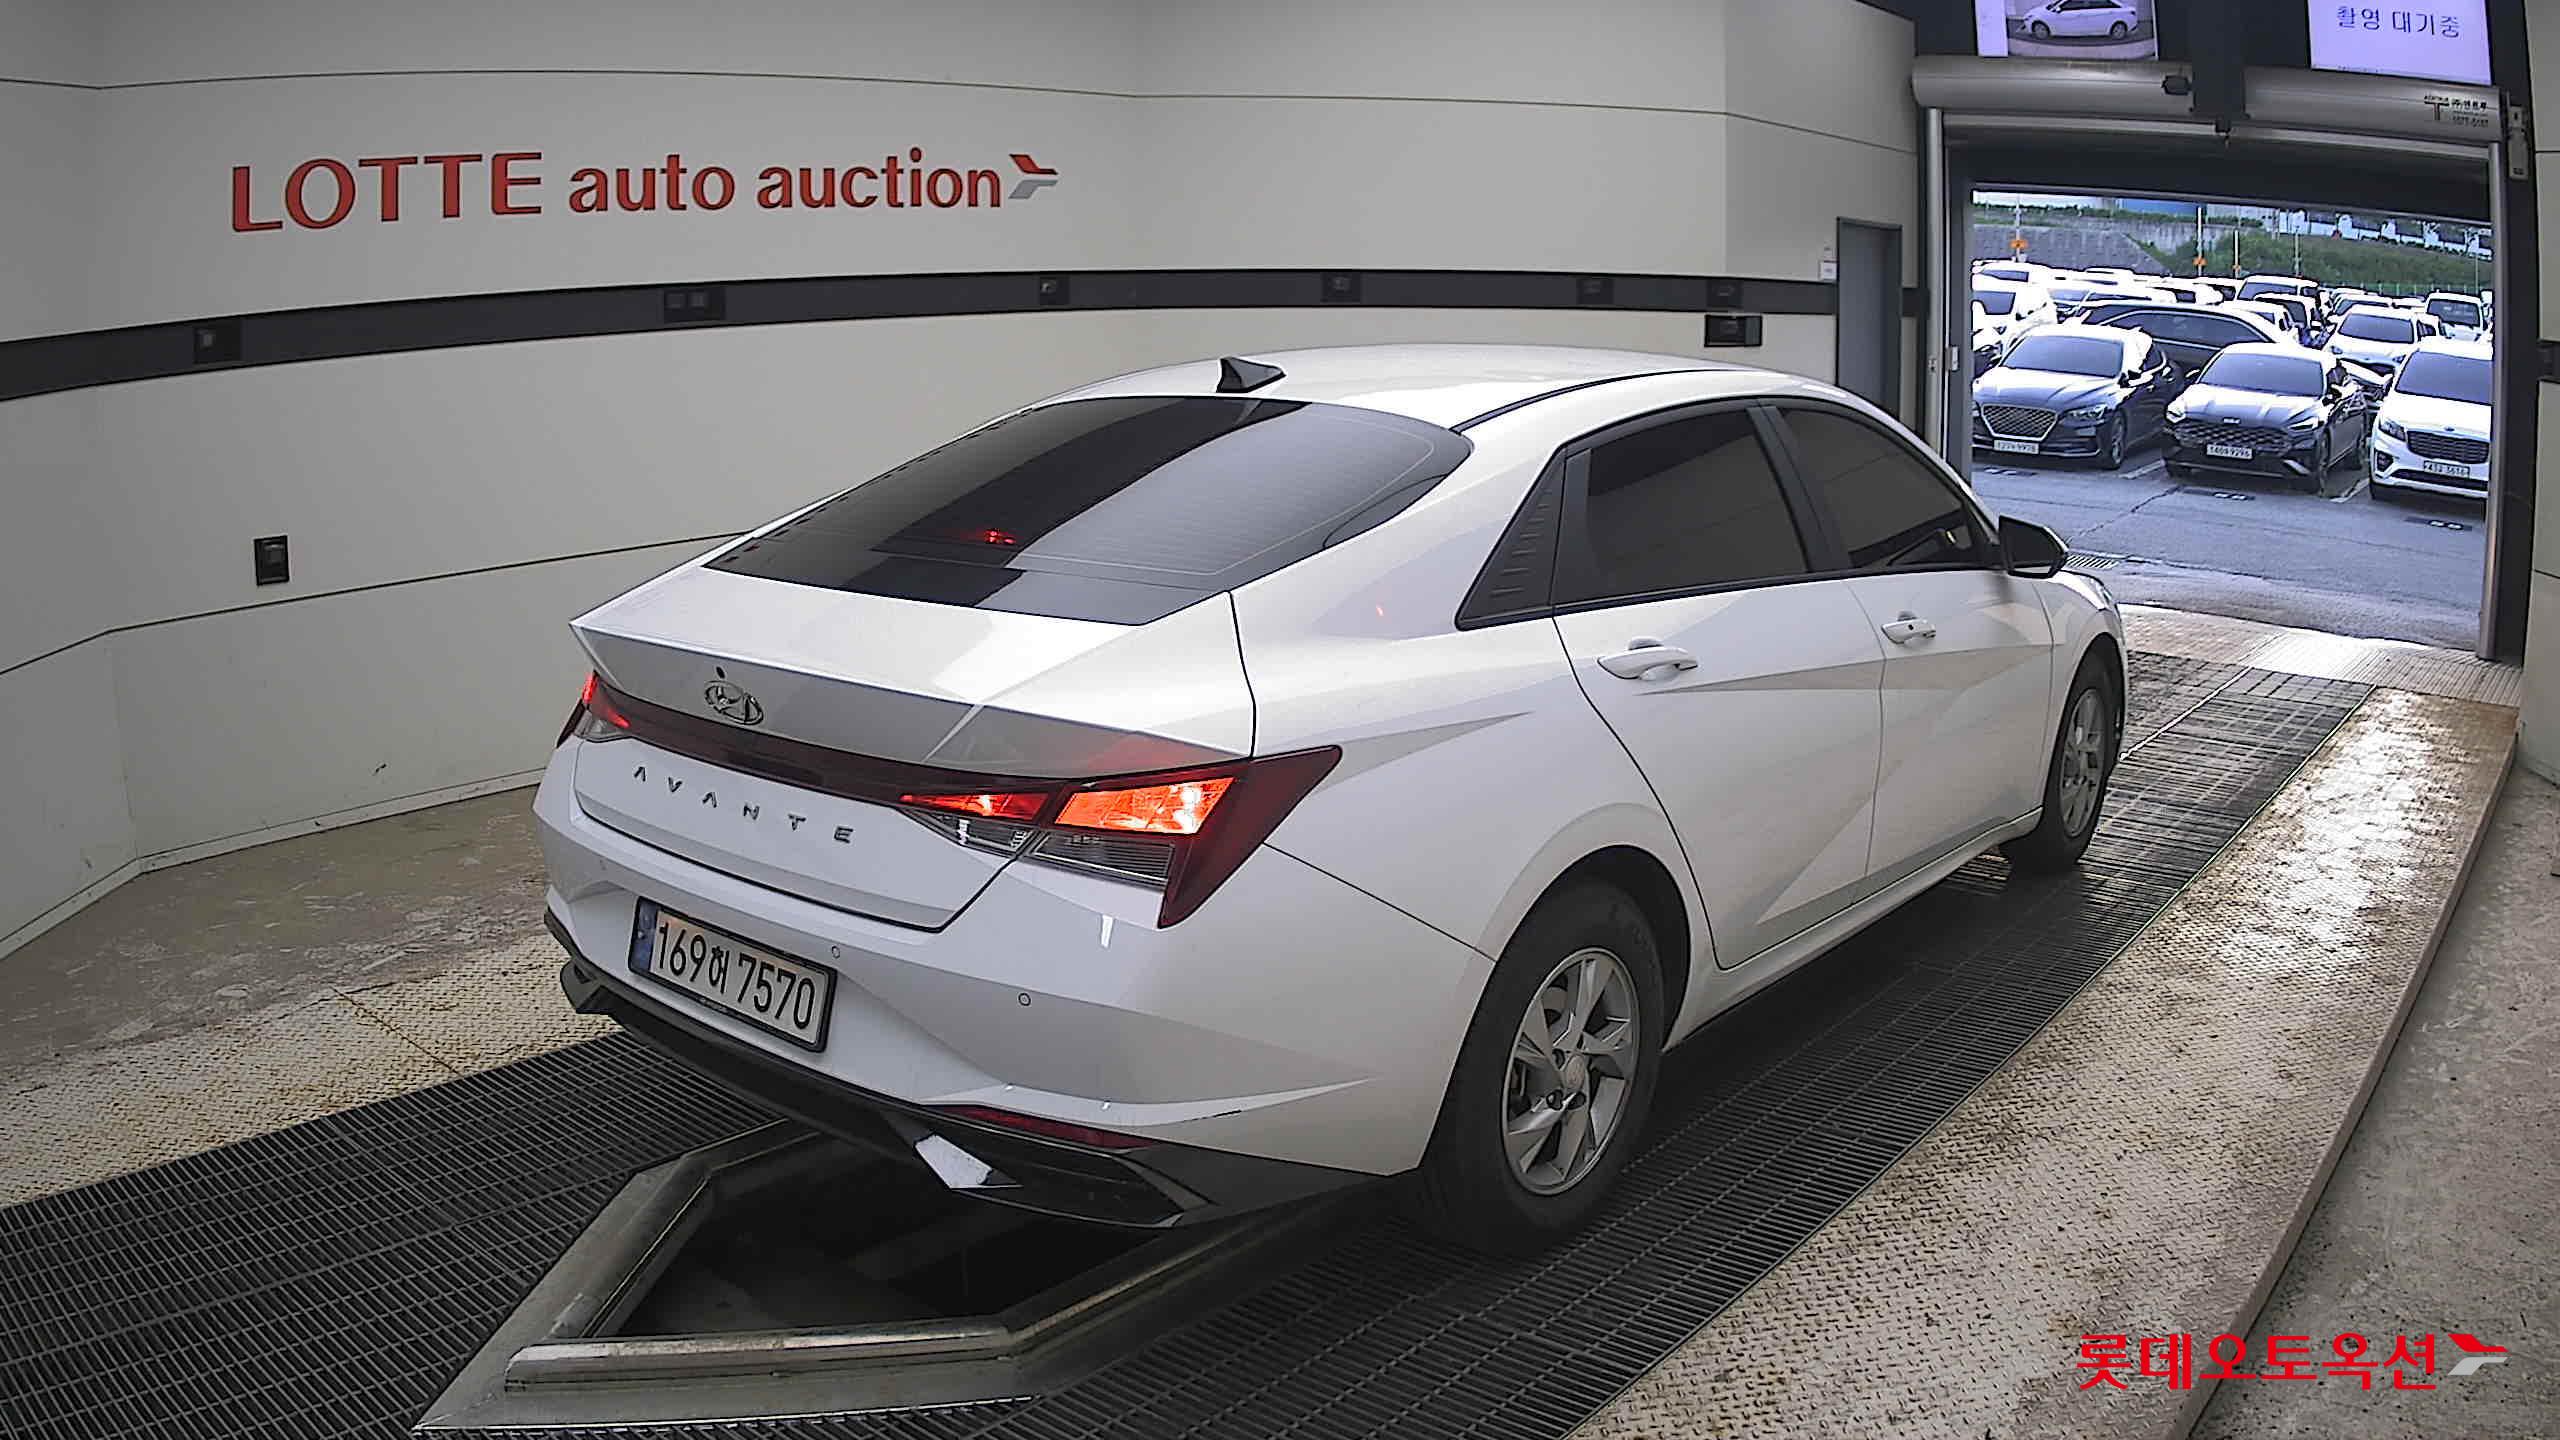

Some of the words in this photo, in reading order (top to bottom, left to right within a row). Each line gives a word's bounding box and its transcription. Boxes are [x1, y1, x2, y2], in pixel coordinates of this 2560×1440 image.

[2337, 6, 2380, 31] 촬영
[2392, 11, 2461, 39] 대기중
[231, 151, 543, 233] LOTTE
[568, 153, 736, 213] auto
[757, 147, 1001, 210] auction
[633, 766, 854, 844] AVANTE
[658, 922, 730, 995] 169허
[737, 952, 816, 1030] 7570
